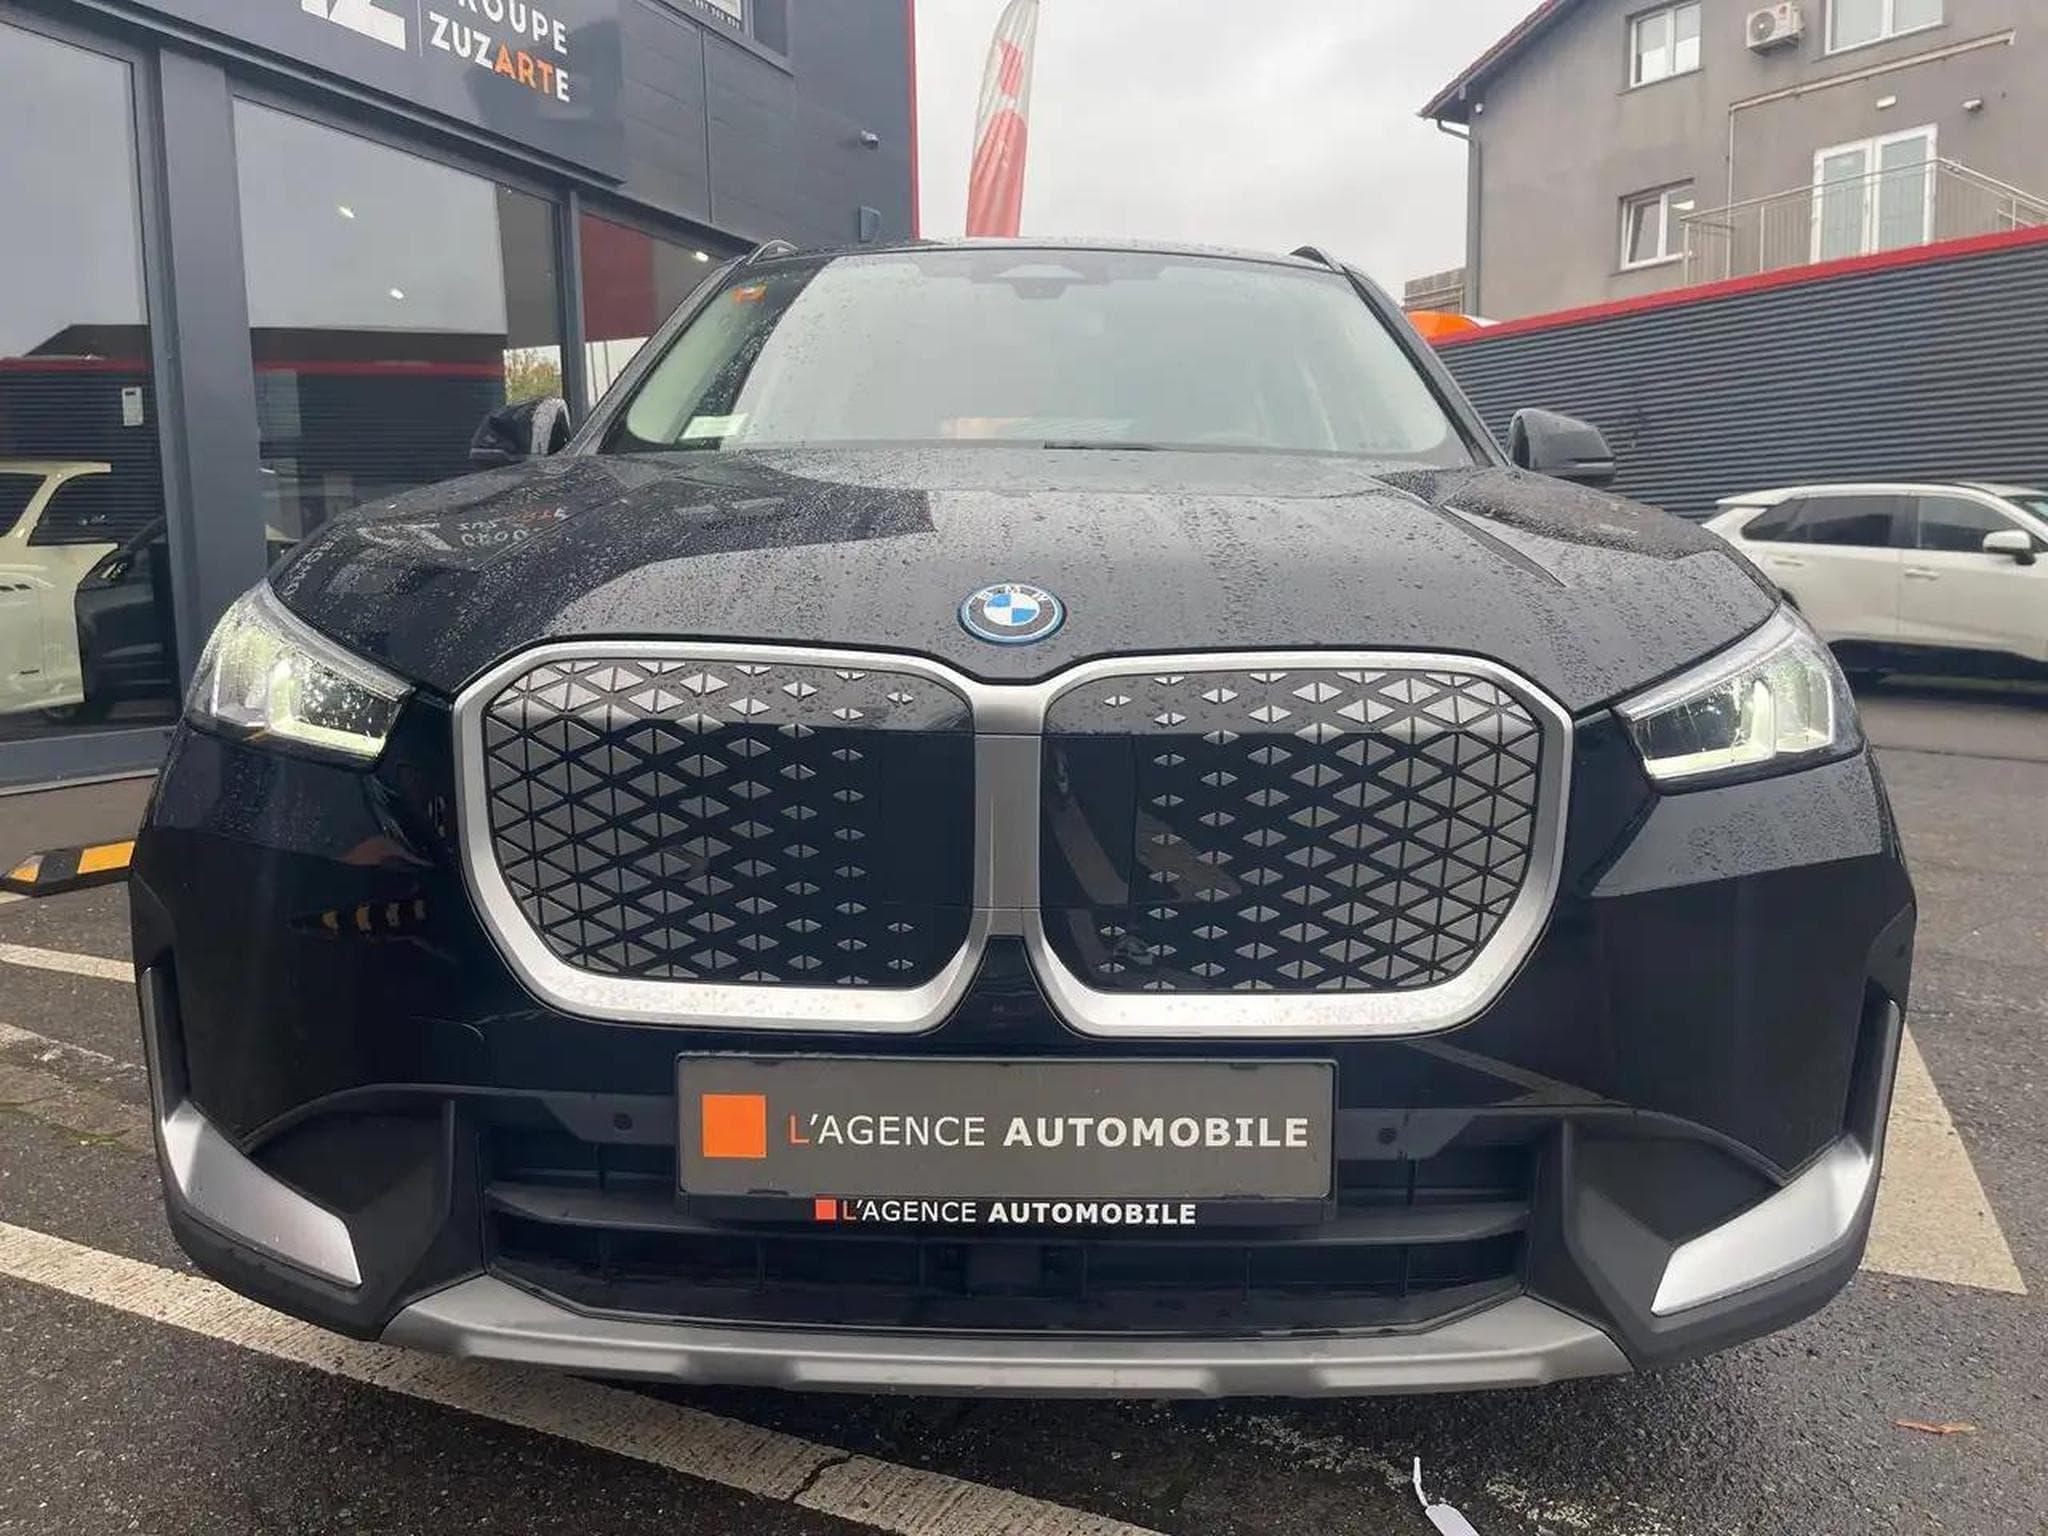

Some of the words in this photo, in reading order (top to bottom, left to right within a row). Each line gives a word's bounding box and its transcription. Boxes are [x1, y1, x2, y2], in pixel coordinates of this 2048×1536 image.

[428, 11, 571, 103] ZUZARTE
[972, 584, 1051, 602] BMW
[788, 1113, 986, 1147] L'AGENCE
[1002, 1117, 1309, 1148] AUTOMOBILE
[843, 1199, 977, 1223] L'AGENCE
[987, 1202, 1197, 1225] AUTOMOBILE
